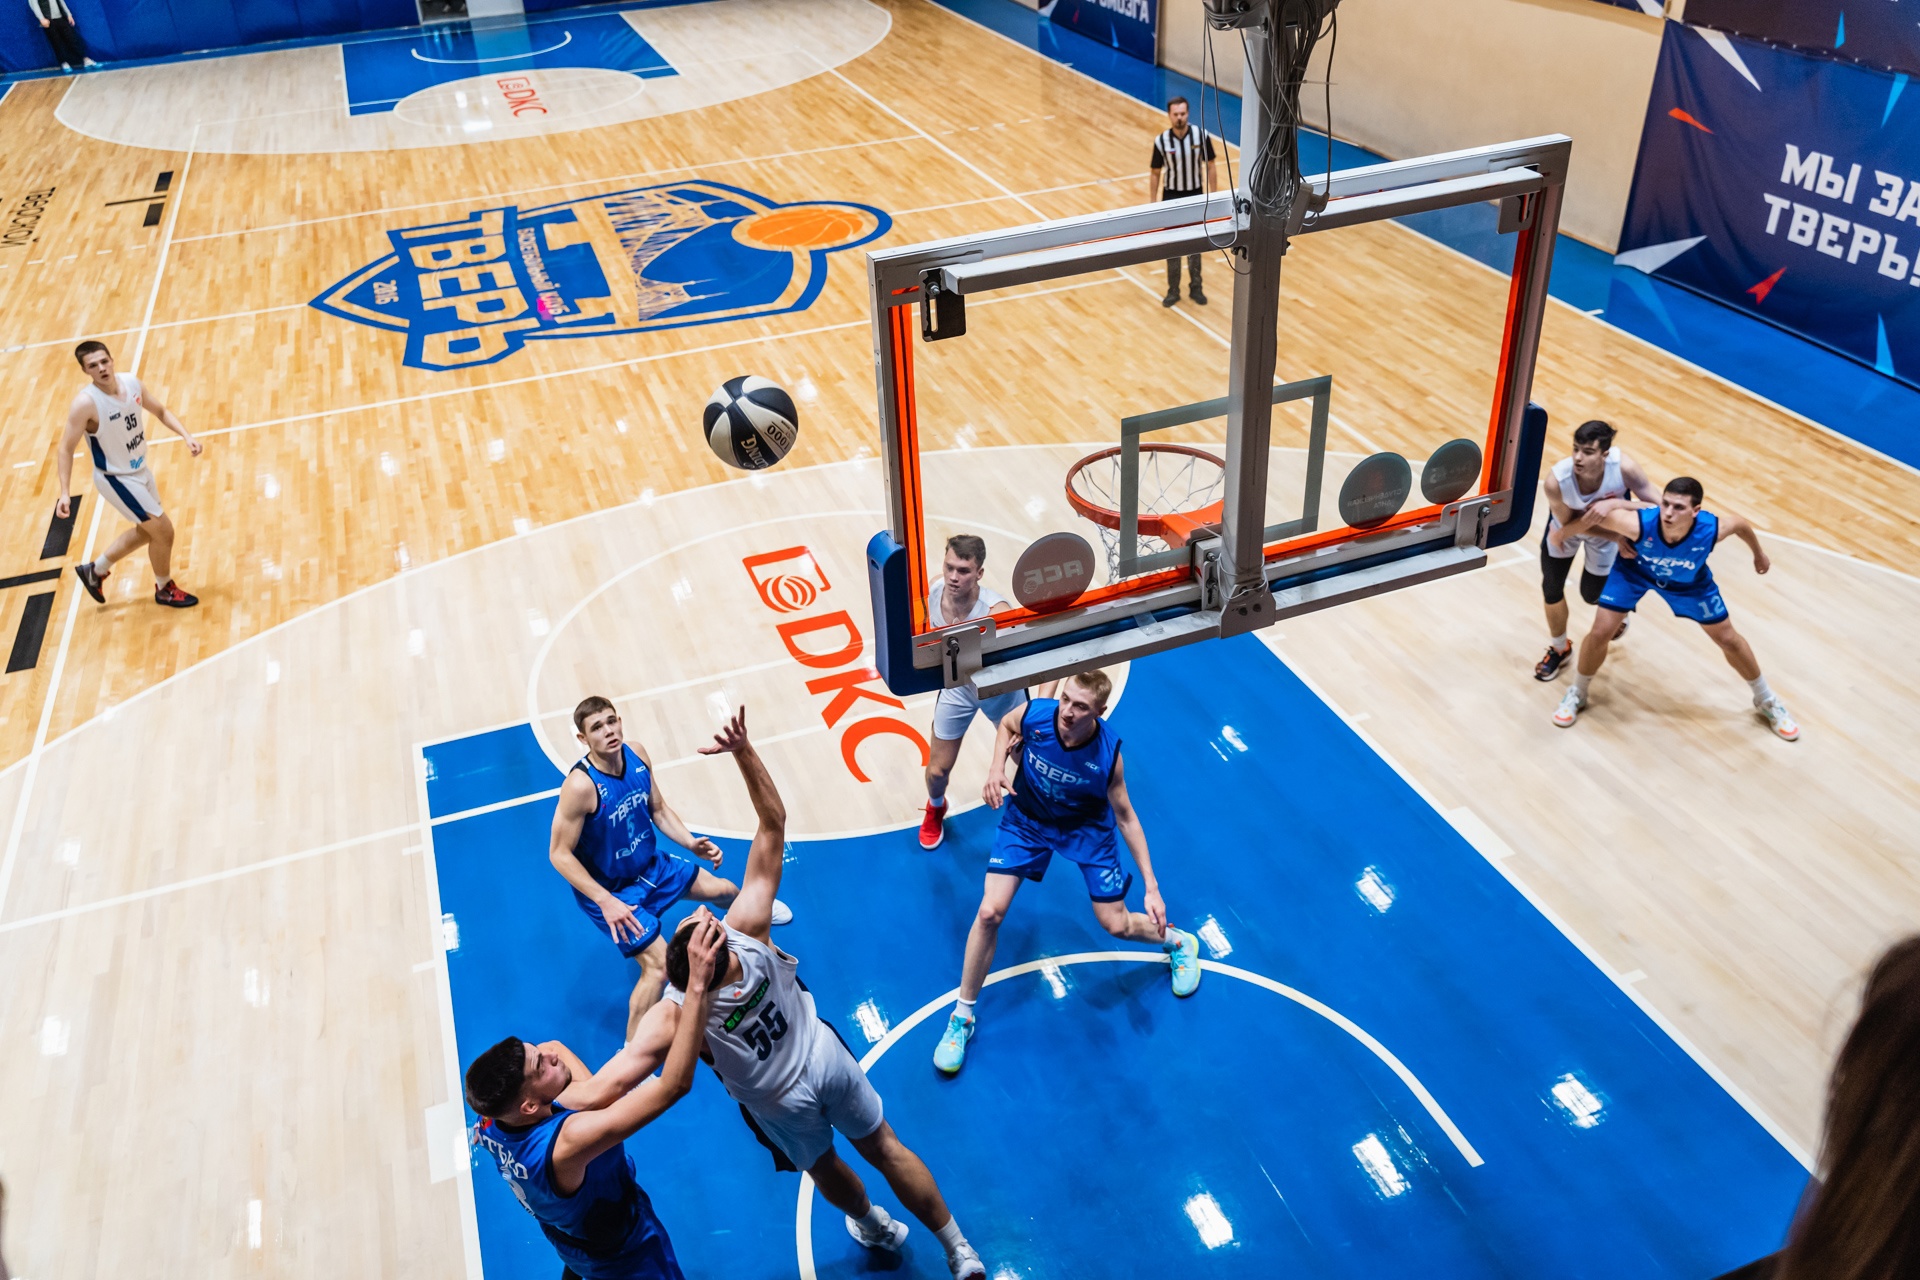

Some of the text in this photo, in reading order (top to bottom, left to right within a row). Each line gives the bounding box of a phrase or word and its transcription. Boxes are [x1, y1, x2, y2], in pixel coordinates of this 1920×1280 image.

[1780, 143, 1920, 228] МЫ ЗА
[400, 210, 541, 367] ТВЕРЬ
[124, 412, 138, 431] 35
[1698, 595, 1725, 619] 12
[775, 609, 931, 784] DKC
[742, 1000, 788, 1062] 55
